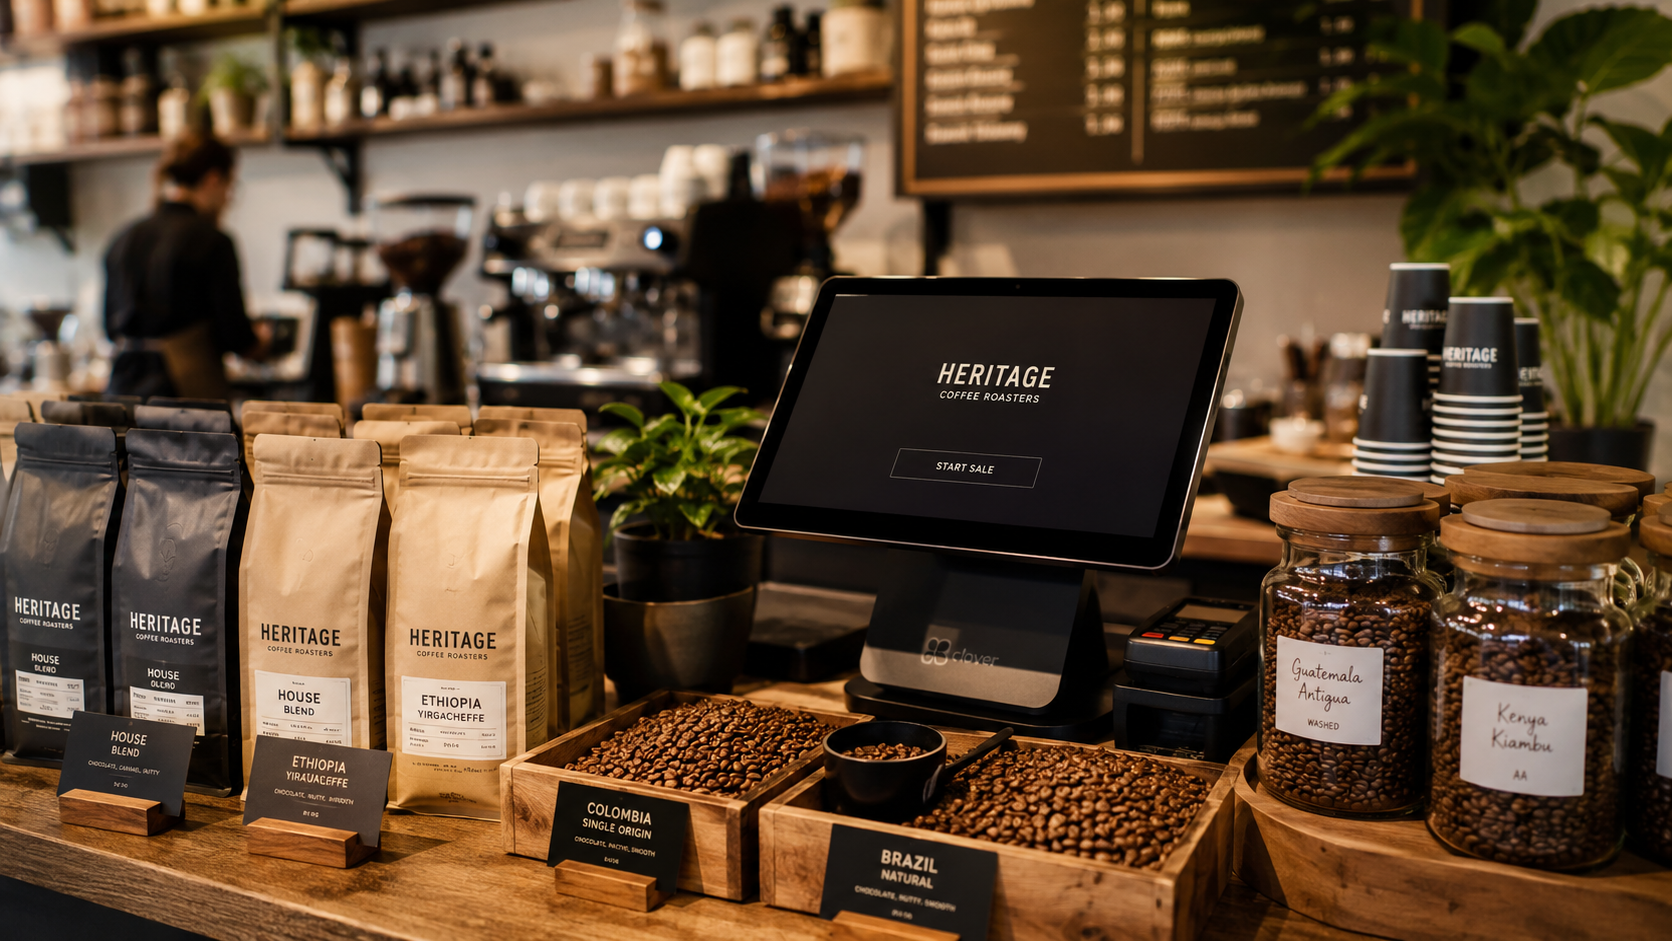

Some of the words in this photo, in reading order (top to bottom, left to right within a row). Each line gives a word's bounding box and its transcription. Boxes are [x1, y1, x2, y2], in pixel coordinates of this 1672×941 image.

[1402, 309, 1448, 325] HERITAG
[1443, 347, 1498, 363] HERITAGE
[936, 362, 1056, 389] HERITAGE
[939, 390, 980, 401] COFFEE
[983, 392, 1040, 404] ROASTERS
[935, 461, 968, 473] START
[969, 464, 995, 475] SALE
[14, 596, 81, 621] HERITAGE
[130, 611, 202, 636] HERITAGE
[261, 622, 341, 647] HERITAGE
[409, 628, 497, 650] HERITAGE
[31, 652, 60, 665] HOUSE
[295, 648, 334, 657] ROASTERS
[448, 652, 488, 661] ROASTERS
[147, 667, 180, 681] HOUSE
[1291, 657, 1363, 684] Guatemala
[278, 688, 321, 704] HOUSE
[421, 694, 482, 710] ETHIOPIA
[1298, 682, 1351, 712] Antigua
[283, 705, 315, 716] BLEND
[417, 710, 485, 723] YIRGACHEFFE
[1307, 718, 1340, 731] WASHED
[1498, 702, 1549, 736] Kenya
[110, 730, 148, 746] HOUSE
[1491, 728, 1553, 753] Kiambu
[111, 745, 140, 758] BLEND
[292, 755, 346, 774] ETHIOPIA
[1512, 769, 1528, 782] AA
[587, 802, 652, 826] COLOMBIA
[582, 818, 616, 834] SINGLE
[618, 825, 652, 840] ORIGIN
[880, 849, 938, 874] BRAZIL
[880, 869, 934, 890] NATURAL
